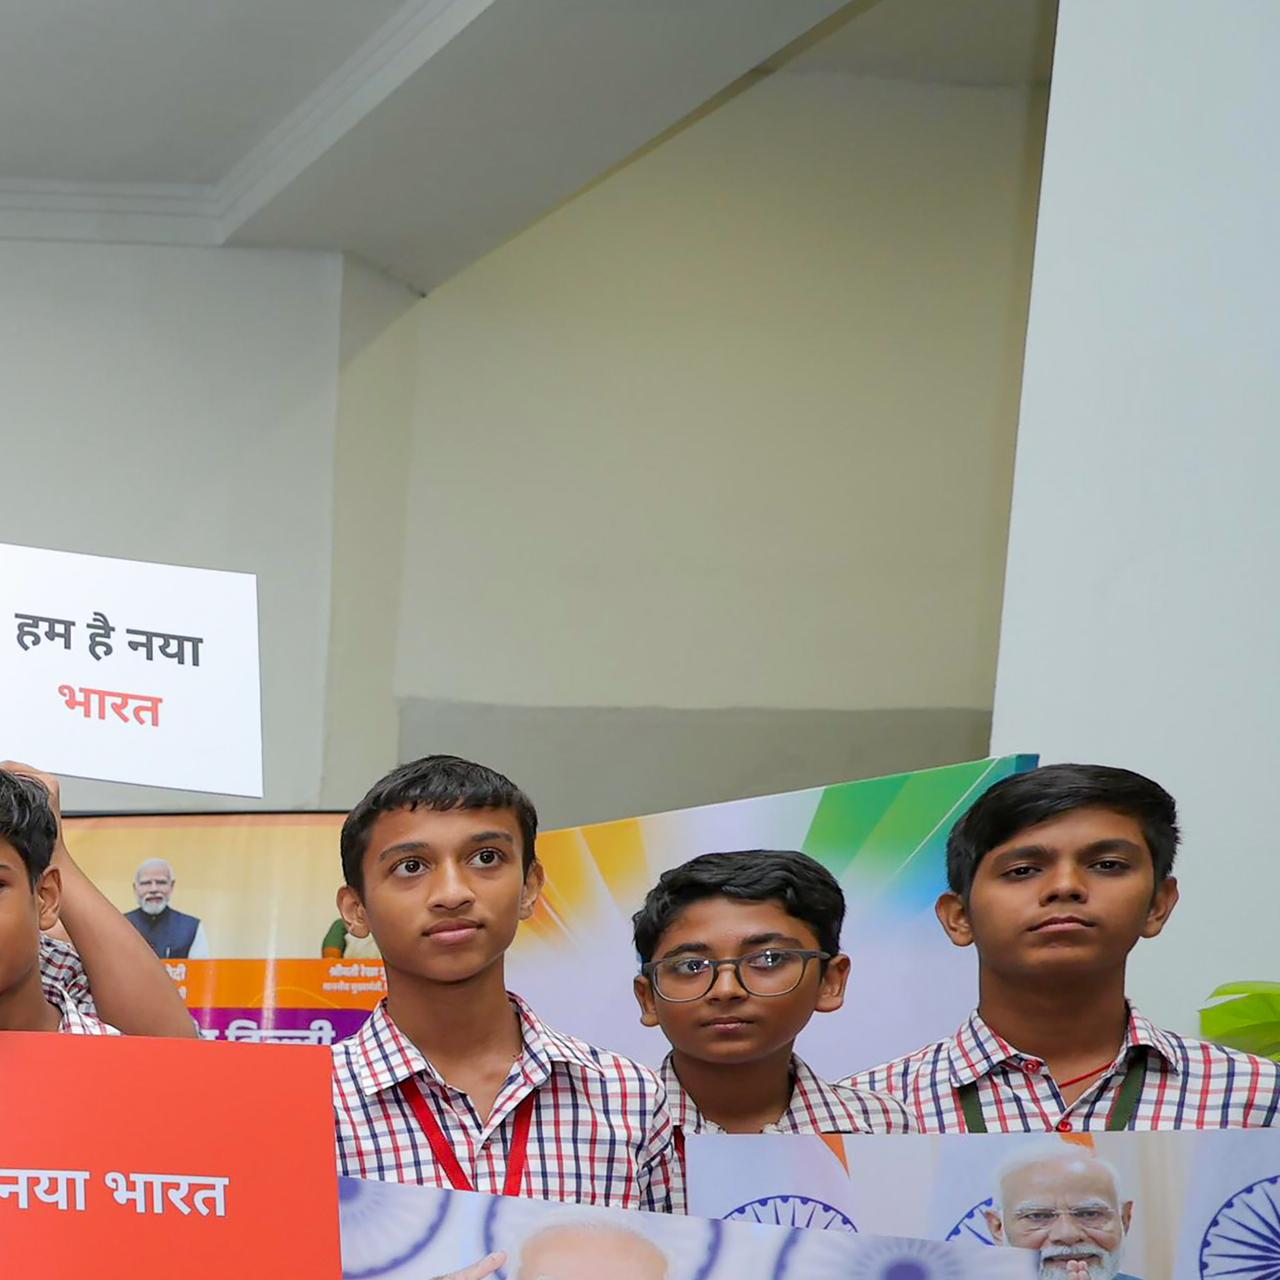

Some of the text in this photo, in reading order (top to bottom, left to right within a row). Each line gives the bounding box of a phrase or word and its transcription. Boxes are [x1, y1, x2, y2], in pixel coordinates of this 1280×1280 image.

[14, 611, 203, 667] हम है नया
[58, 684, 163, 728] भारत
[104, 1169, 230, 1217] भारत
